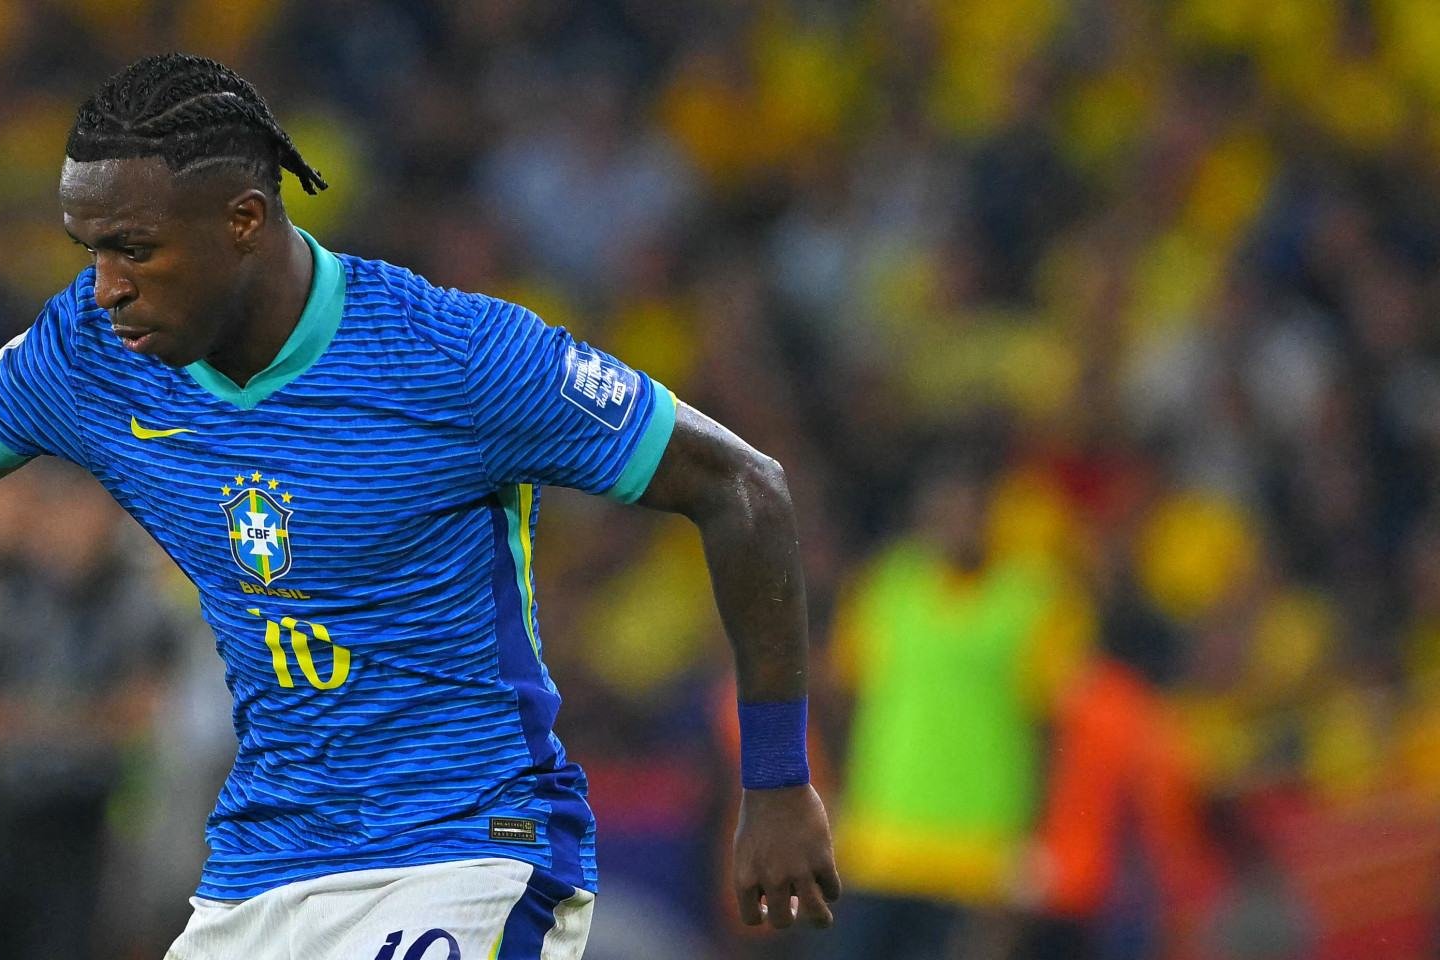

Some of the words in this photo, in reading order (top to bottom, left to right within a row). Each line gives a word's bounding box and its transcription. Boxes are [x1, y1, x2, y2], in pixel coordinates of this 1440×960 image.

[613, 384, 625, 403] FIFA
[246, 527, 271, 540] CBF
[239, 580, 311, 600] BRASIL
[247, 608, 351, 690] 10
